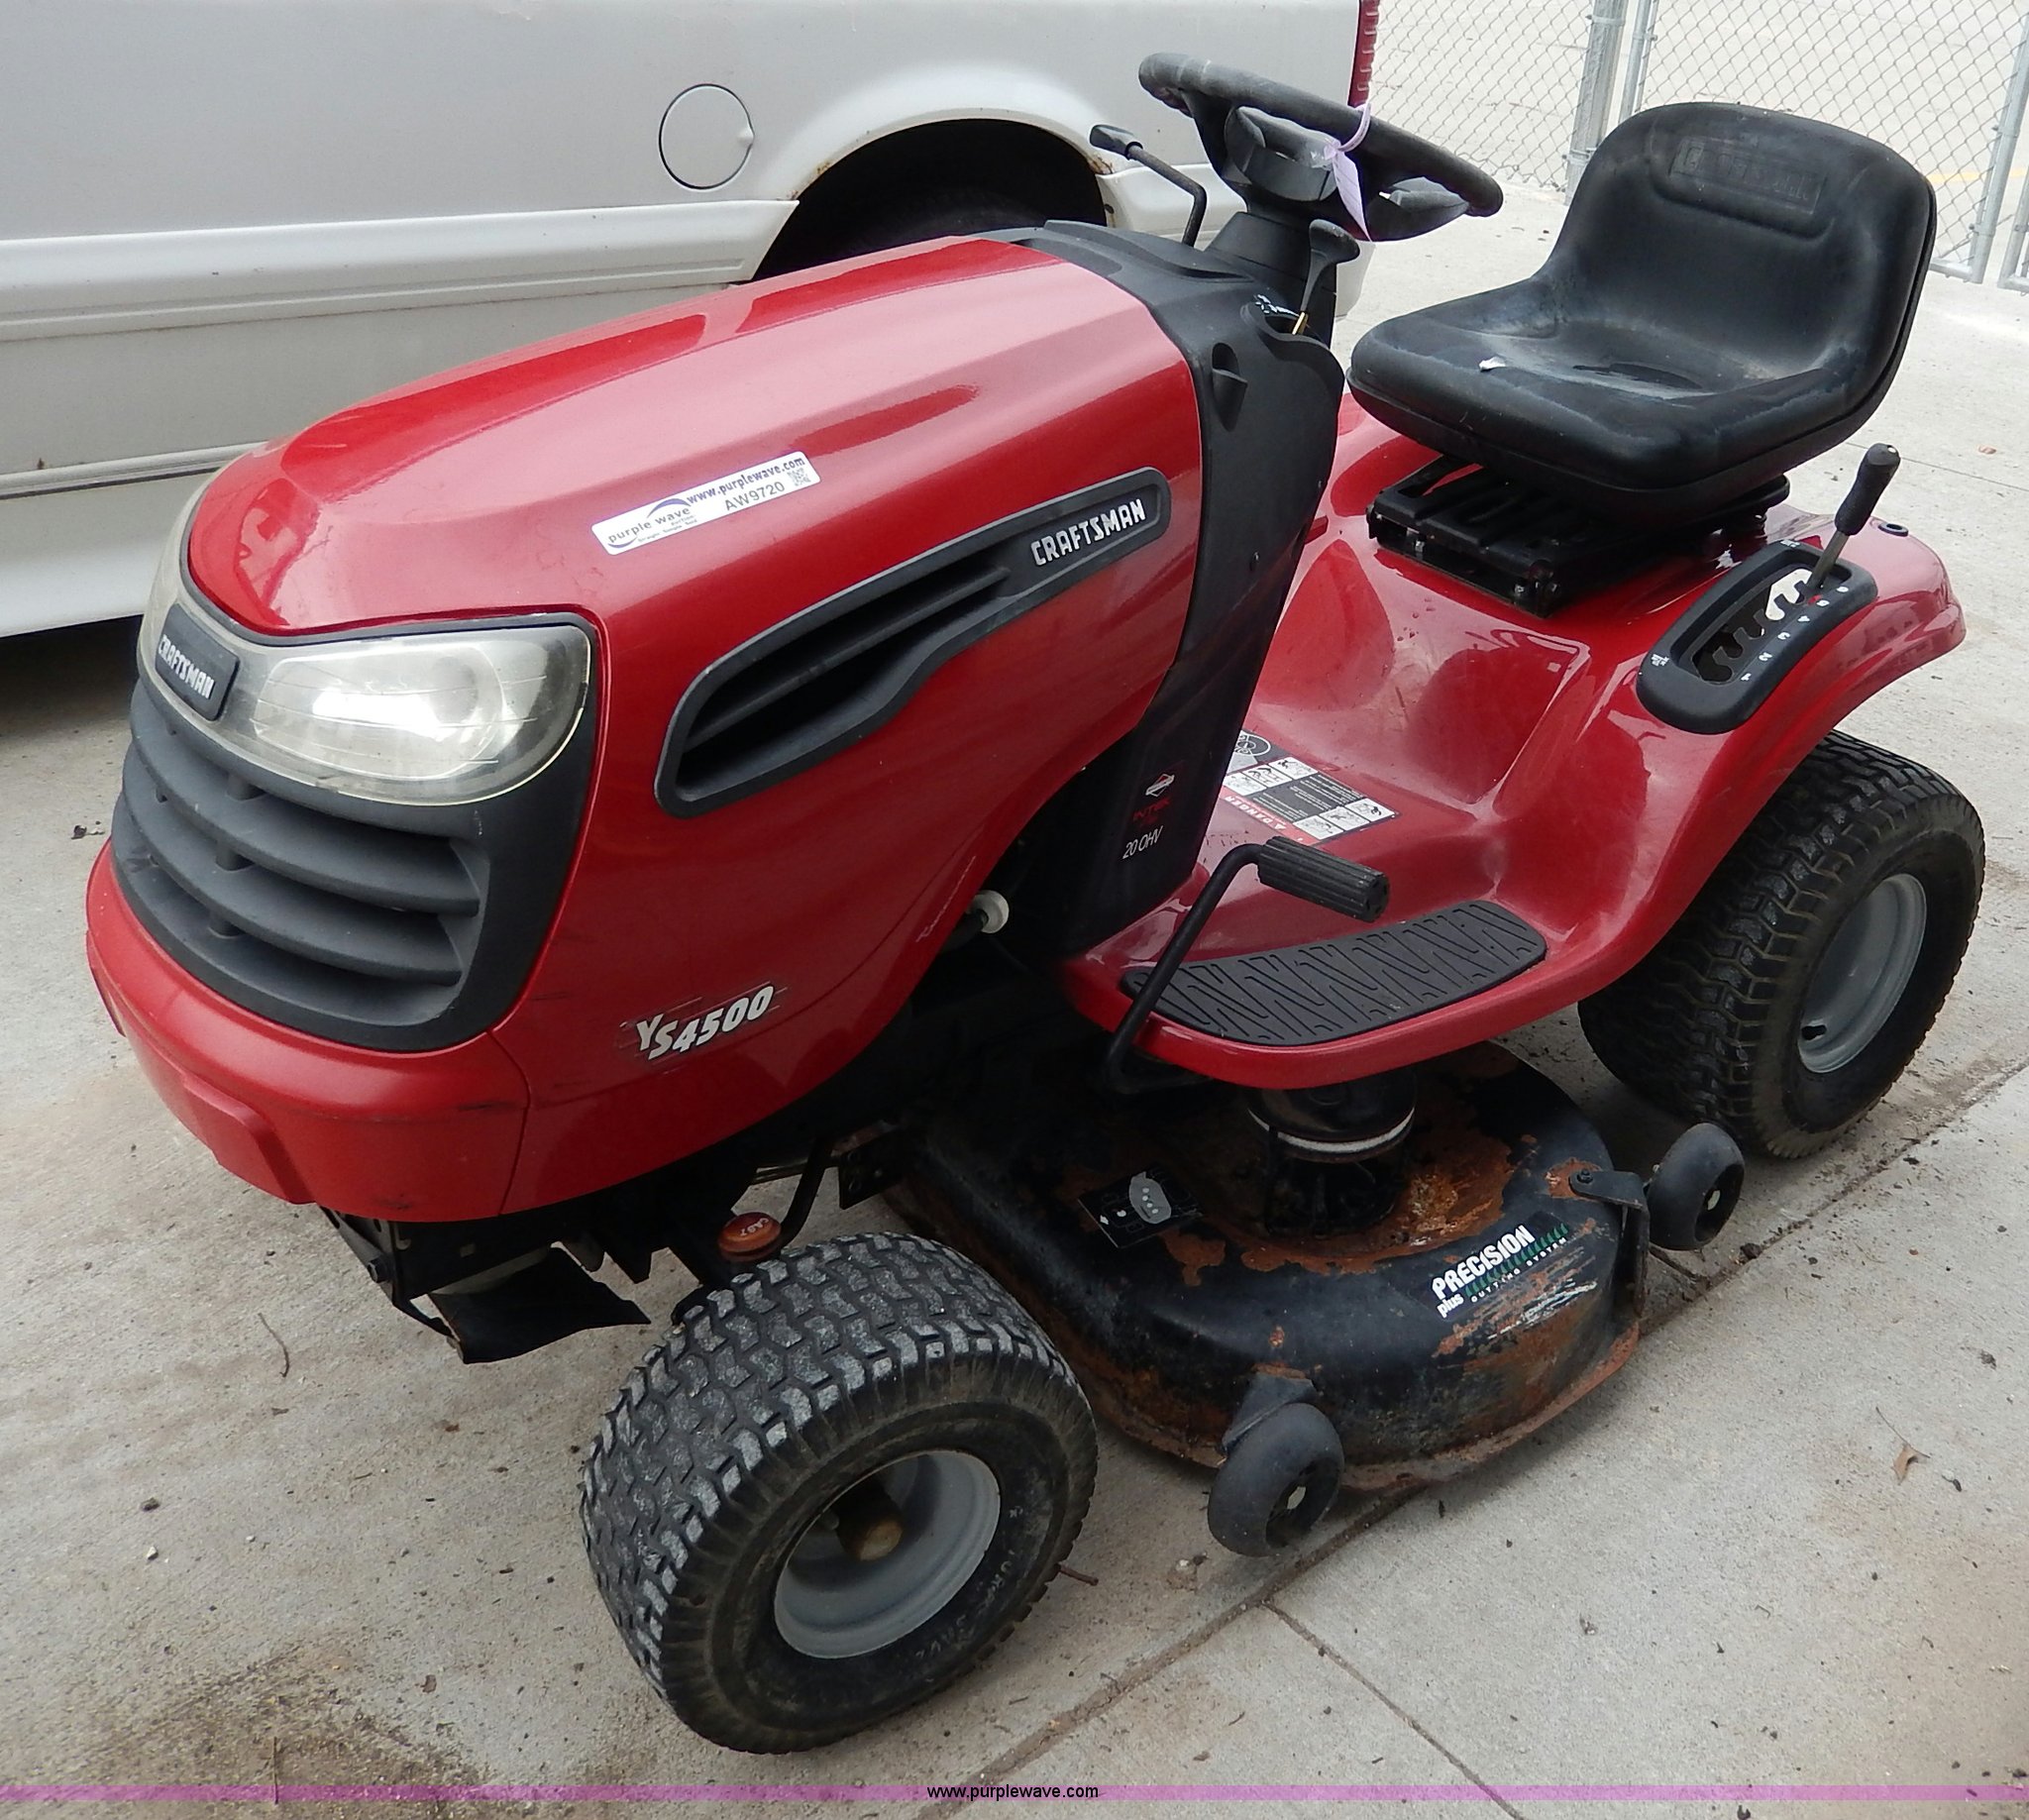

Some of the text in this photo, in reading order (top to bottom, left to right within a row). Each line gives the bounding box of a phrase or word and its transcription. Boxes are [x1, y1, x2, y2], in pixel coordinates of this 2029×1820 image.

[686, 457, 805, 504] www.purplewave.com
[724, 481, 786, 511] AW9720
[607, 507, 691, 544] purple wave
[1030, 498, 1146, 566] CRAFTSMAN
[159, 634, 215, 699] CRAFTSMAN
[1225, 796, 1273, 824] DANGER
[1122, 825, 1164, 859] 20 OHV
[636, 986, 775, 1060] YS4500
[1432, 1225, 1536, 1300] PRECISION
[1437, 1293, 1464, 1319] plus
